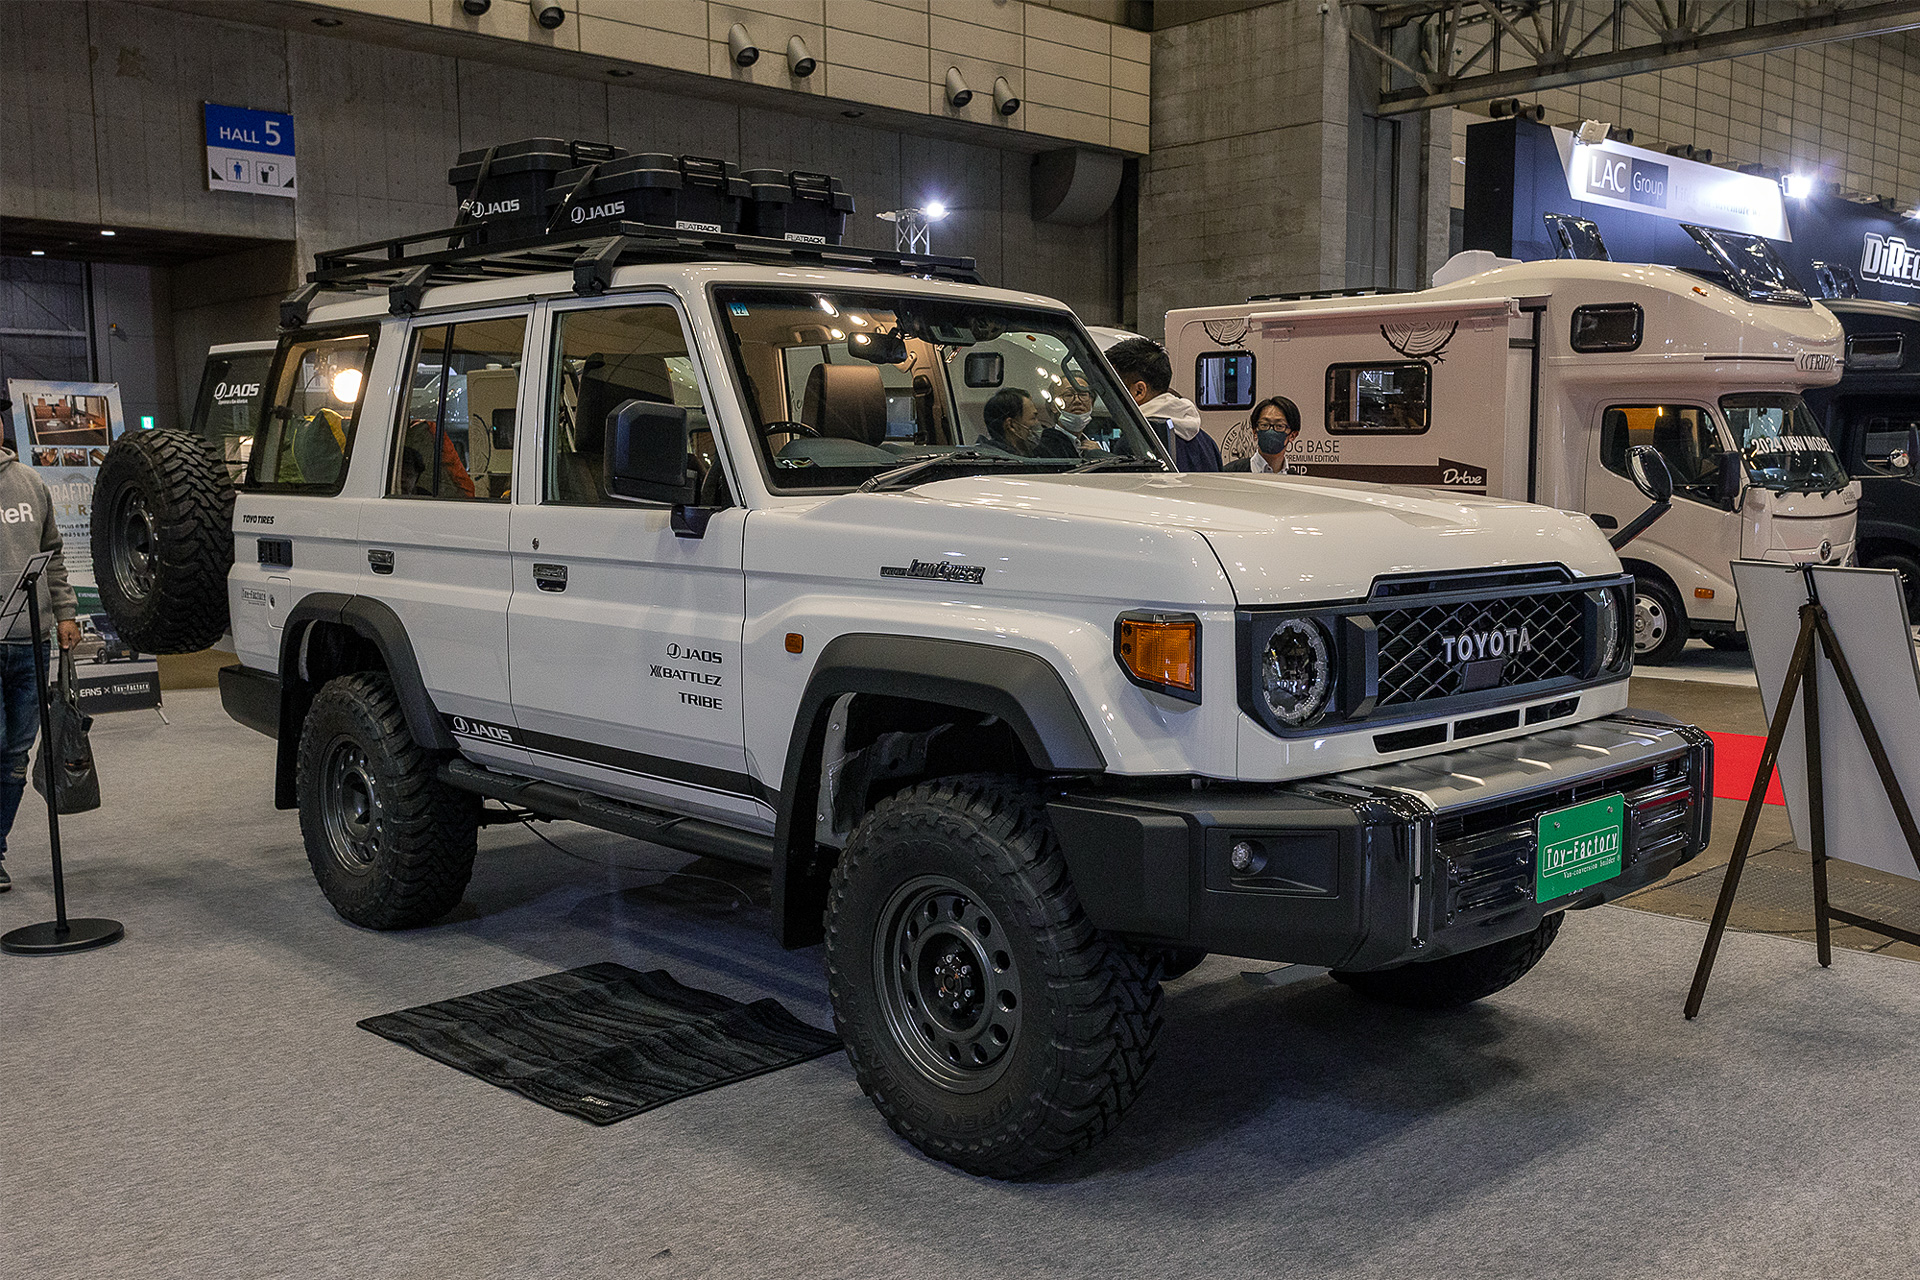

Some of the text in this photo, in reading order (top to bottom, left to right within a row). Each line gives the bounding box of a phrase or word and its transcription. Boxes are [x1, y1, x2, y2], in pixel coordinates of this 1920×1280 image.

[220, 121, 281, 146] HALL 5
[1590, 155, 1627, 193] LAC
[1633, 171, 1664, 200] Group
[484, 199, 520, 216] JAOS
[585, 201, 625, 221] JAOS
[224, 383, 260, 398] JAOS
[1307, 440, 1340, 453] BASE
[1751, 437, 1783, 455] 2024
[1314, 455, 1340, 463] EDITION
[242, 514, 275, 525] TOYO TIRES
[1442, 627, 1532, 664] TOYOTA
[681, 648, 723, 664] JAOS
[678, 691, 723, 710] TRIBE
[470, 722, 513, 742] JAOS
[1547, 832, 1618, 868] Toy-Factory
